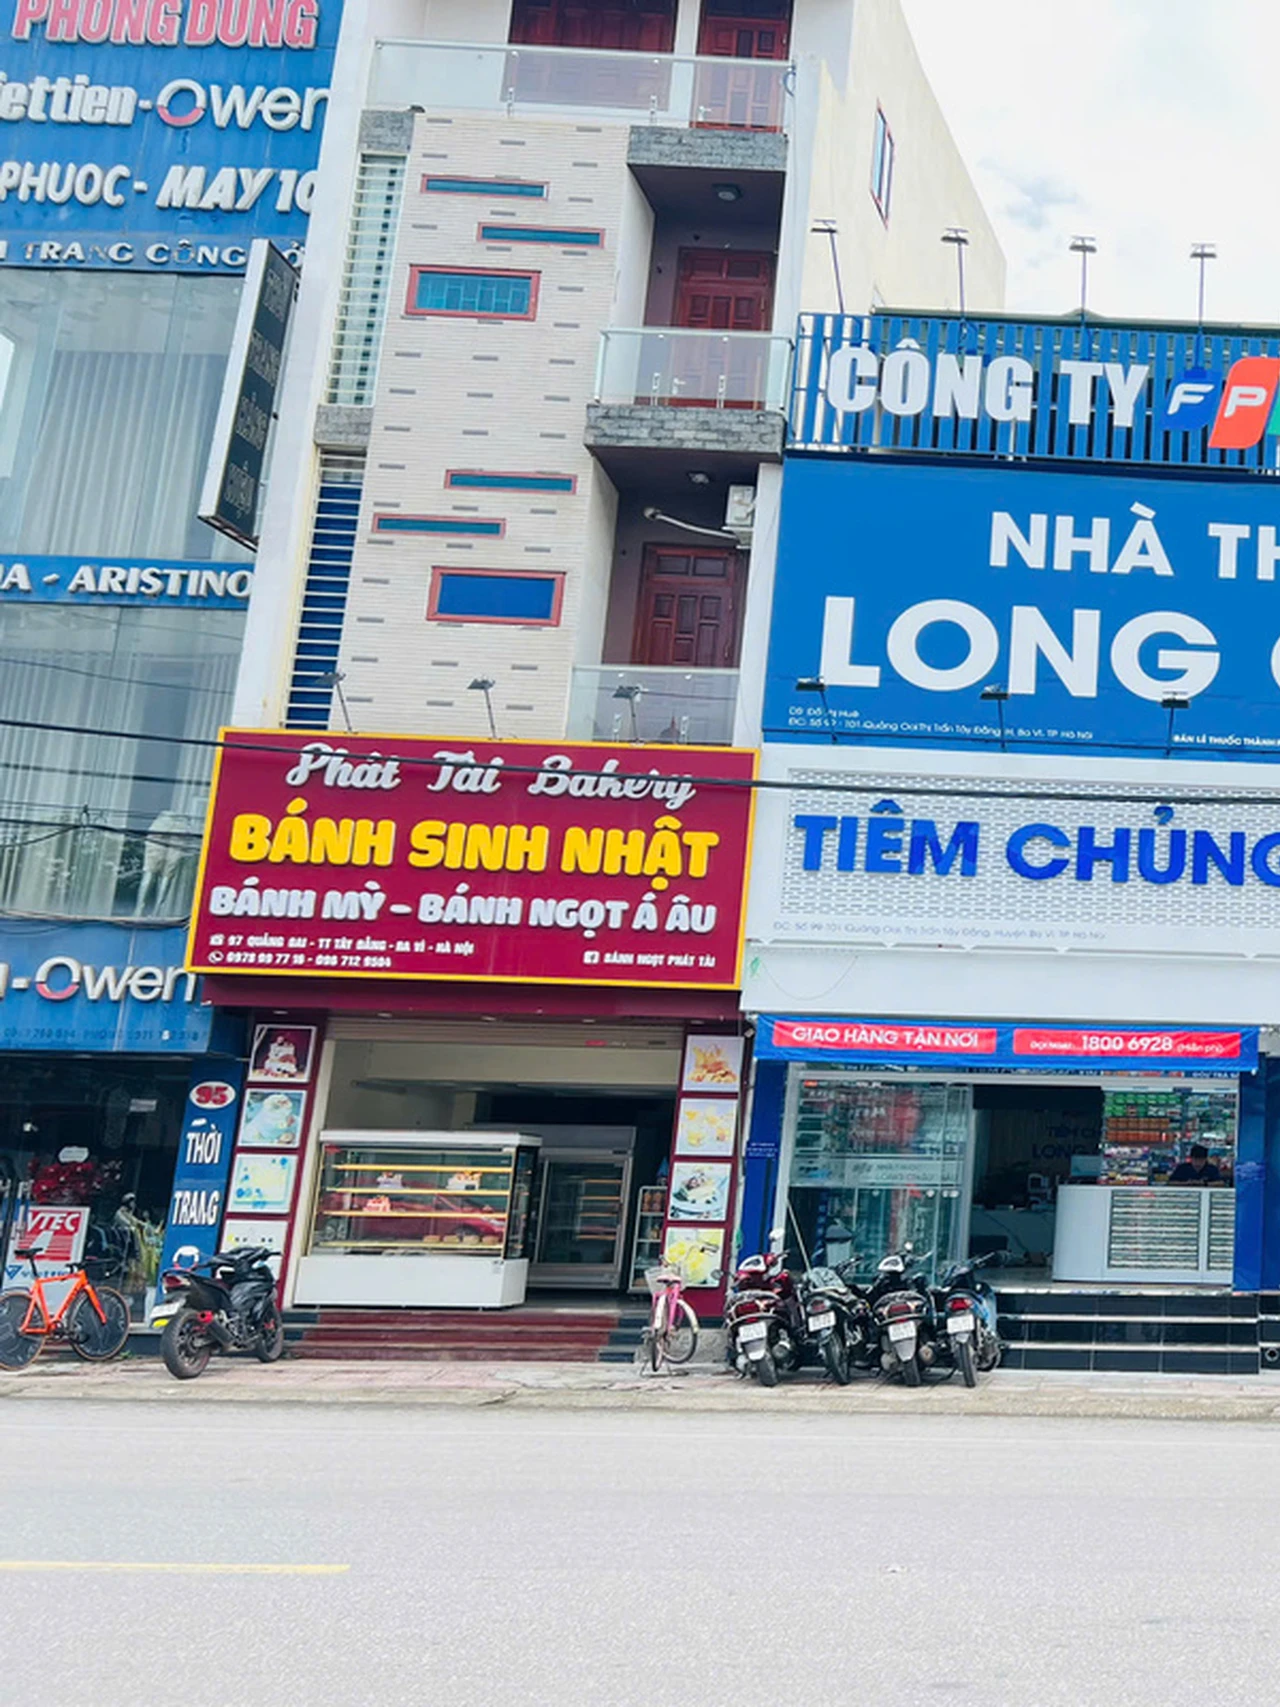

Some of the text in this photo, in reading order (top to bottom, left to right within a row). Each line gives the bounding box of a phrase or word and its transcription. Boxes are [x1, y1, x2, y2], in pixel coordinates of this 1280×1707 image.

[155, 165, 273, 213] MAY
[826, 338, 1034, 423] CÔNG
[1060, 360, 1149, 428] TY
[990, 501, 1174, 577] NHÀ
[68, 565, 254, 598] ARISTINO
[820, 595, 1221, 702] LONG
[285, 742, 401, 790] Phát
[527, 754, 697, 810] Bakery
[230, 797, 720, 891] BÁNH SINH NHẬT
[795, 800, 980, 877] TIÊM
[209, 876, 316, 919] BÁNH
[321, 880, 386, 921] MỲ
[418, 883, 523, 926] BÁNH
[529, 896, 630, 939] NGỌT
[632, 891, 658, 931] Á
[665, 893, 718, 934] ÂU
[35, 956, 197, 1001] Owen
[792, 1024, 978, 1050] GIAO HÀNG TẬN NƠI
[1082, 1035, 1124, 1051] 1800
[1127, 1036, 1174, 1052] 6928
[196, 1086, 228, 1105] 95
[186, 1123, 222, 1164] THỜI
